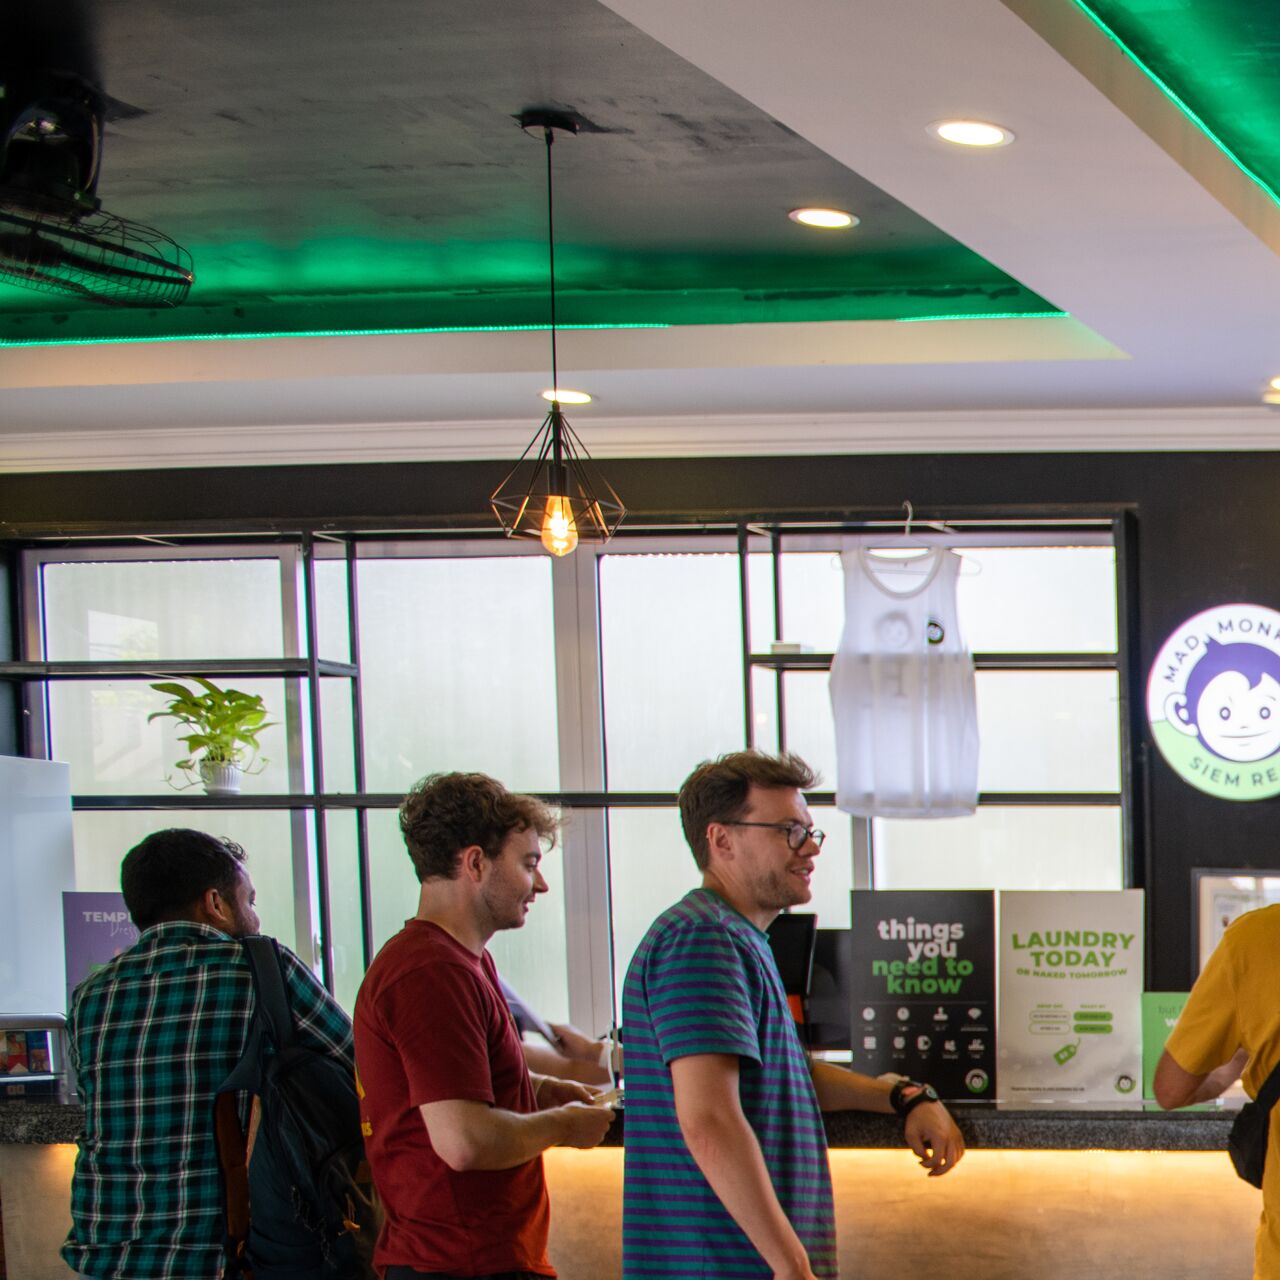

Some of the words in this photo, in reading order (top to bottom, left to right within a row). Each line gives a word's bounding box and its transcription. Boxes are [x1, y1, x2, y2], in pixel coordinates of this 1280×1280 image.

[1163, 634, 1200, 683] MAD
[1189, 756, 1240, 788] SIEM
[877, 916, 965, 945] things
[1011, 930, 1135, 950] LAUNDRY
[907, 941, 958, 963] you
[1030, 950, 1116, 968] TODAY
[872, 957, 938, 977] need
[945, 958, 974, 977] to
[1069, 967, 1128, 979] TOMORROW
[886, 974, 962, 994] know
